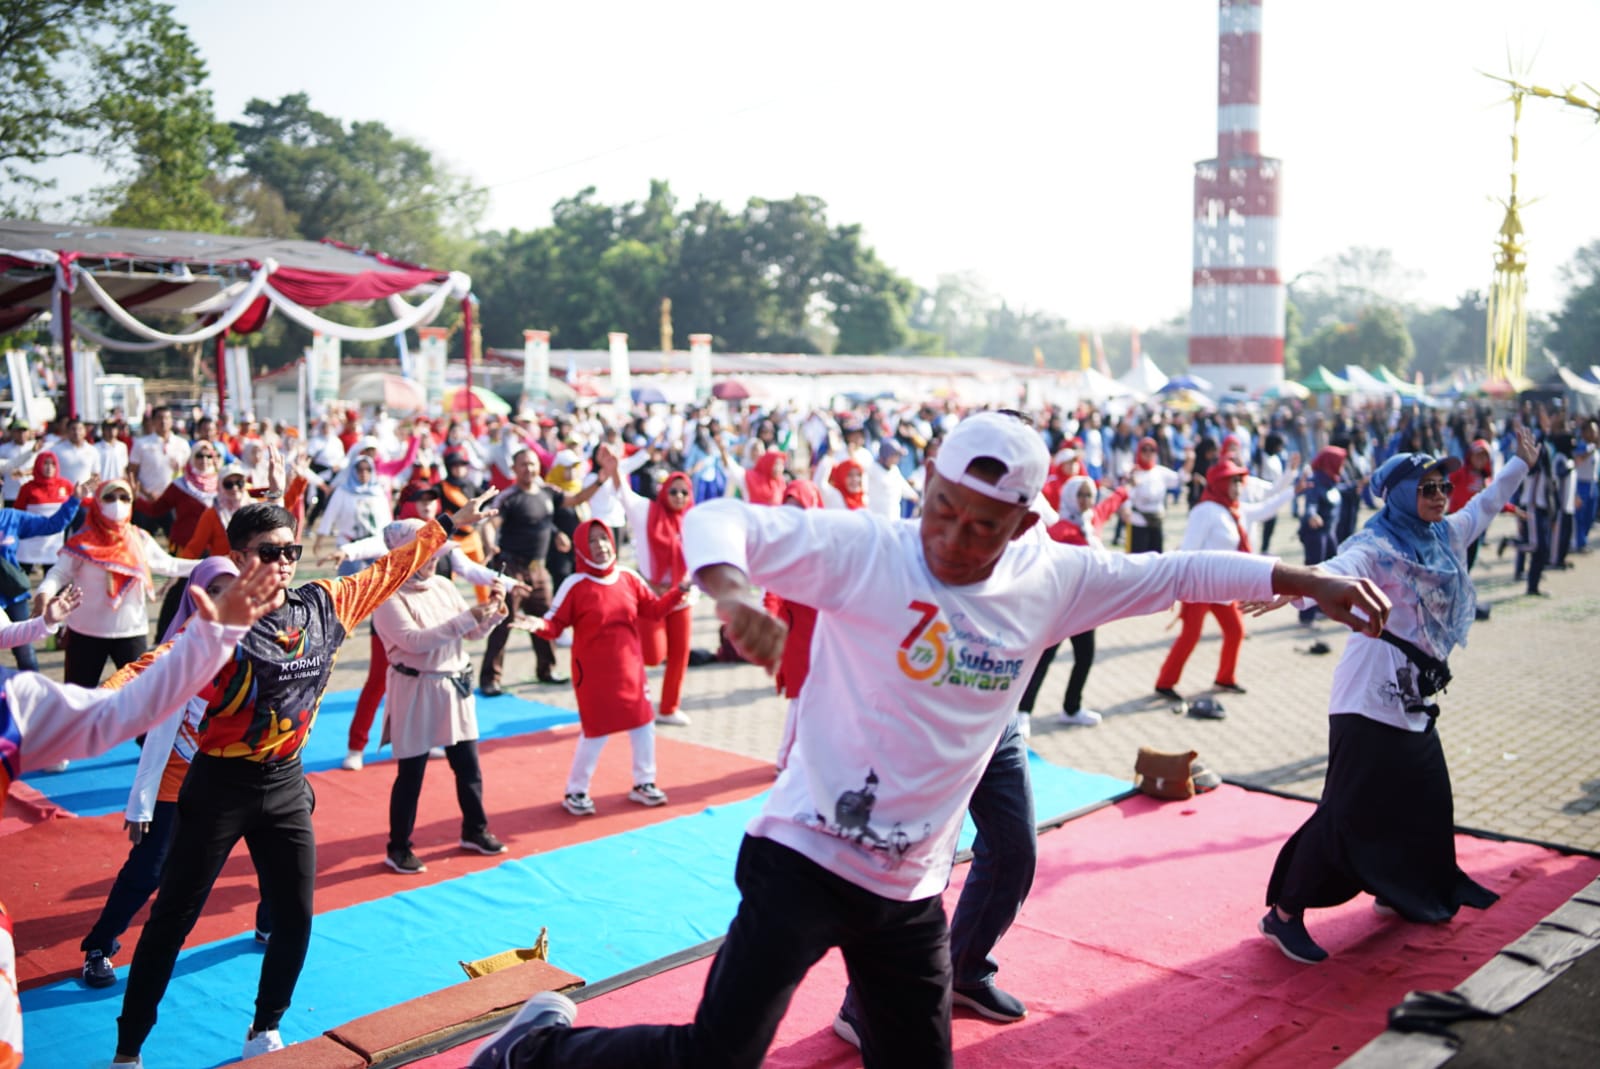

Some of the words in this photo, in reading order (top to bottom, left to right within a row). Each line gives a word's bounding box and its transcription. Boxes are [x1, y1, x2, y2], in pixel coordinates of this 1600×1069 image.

[281, 656, 320, 672] KORMI
[957, 646, 1024, 680] Subang
[294, 669, 320, 679] SUBANG
